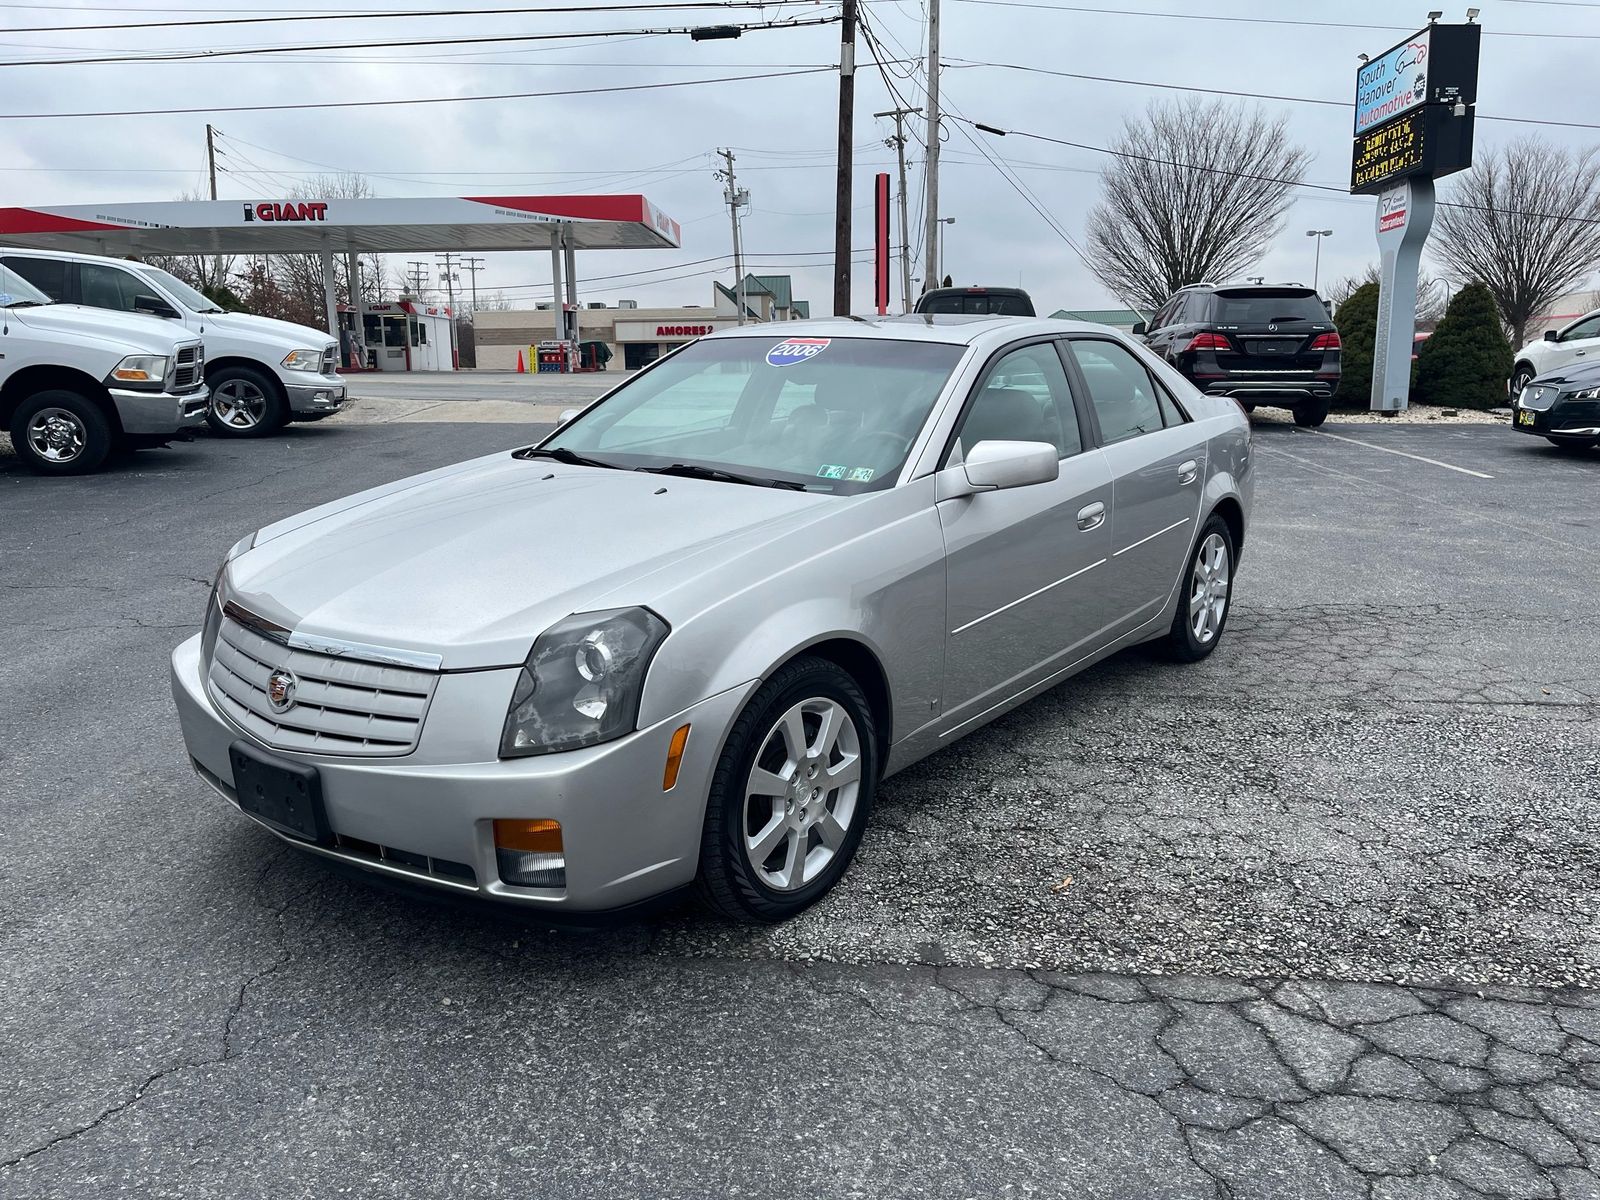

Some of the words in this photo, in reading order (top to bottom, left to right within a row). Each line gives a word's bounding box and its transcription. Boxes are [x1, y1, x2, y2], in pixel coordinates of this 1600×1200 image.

[1360, 60, 1386, 90] South
[1359, 77, 1397, 108] Hanover
[1358, 91, 1412, 129] Automotive
[256, 203, 328, 221] GIANT
[656, 326, 706, 336] AMORES
[707, 325, 714, 335] 2
[771, 344, 822, 356] 2006
